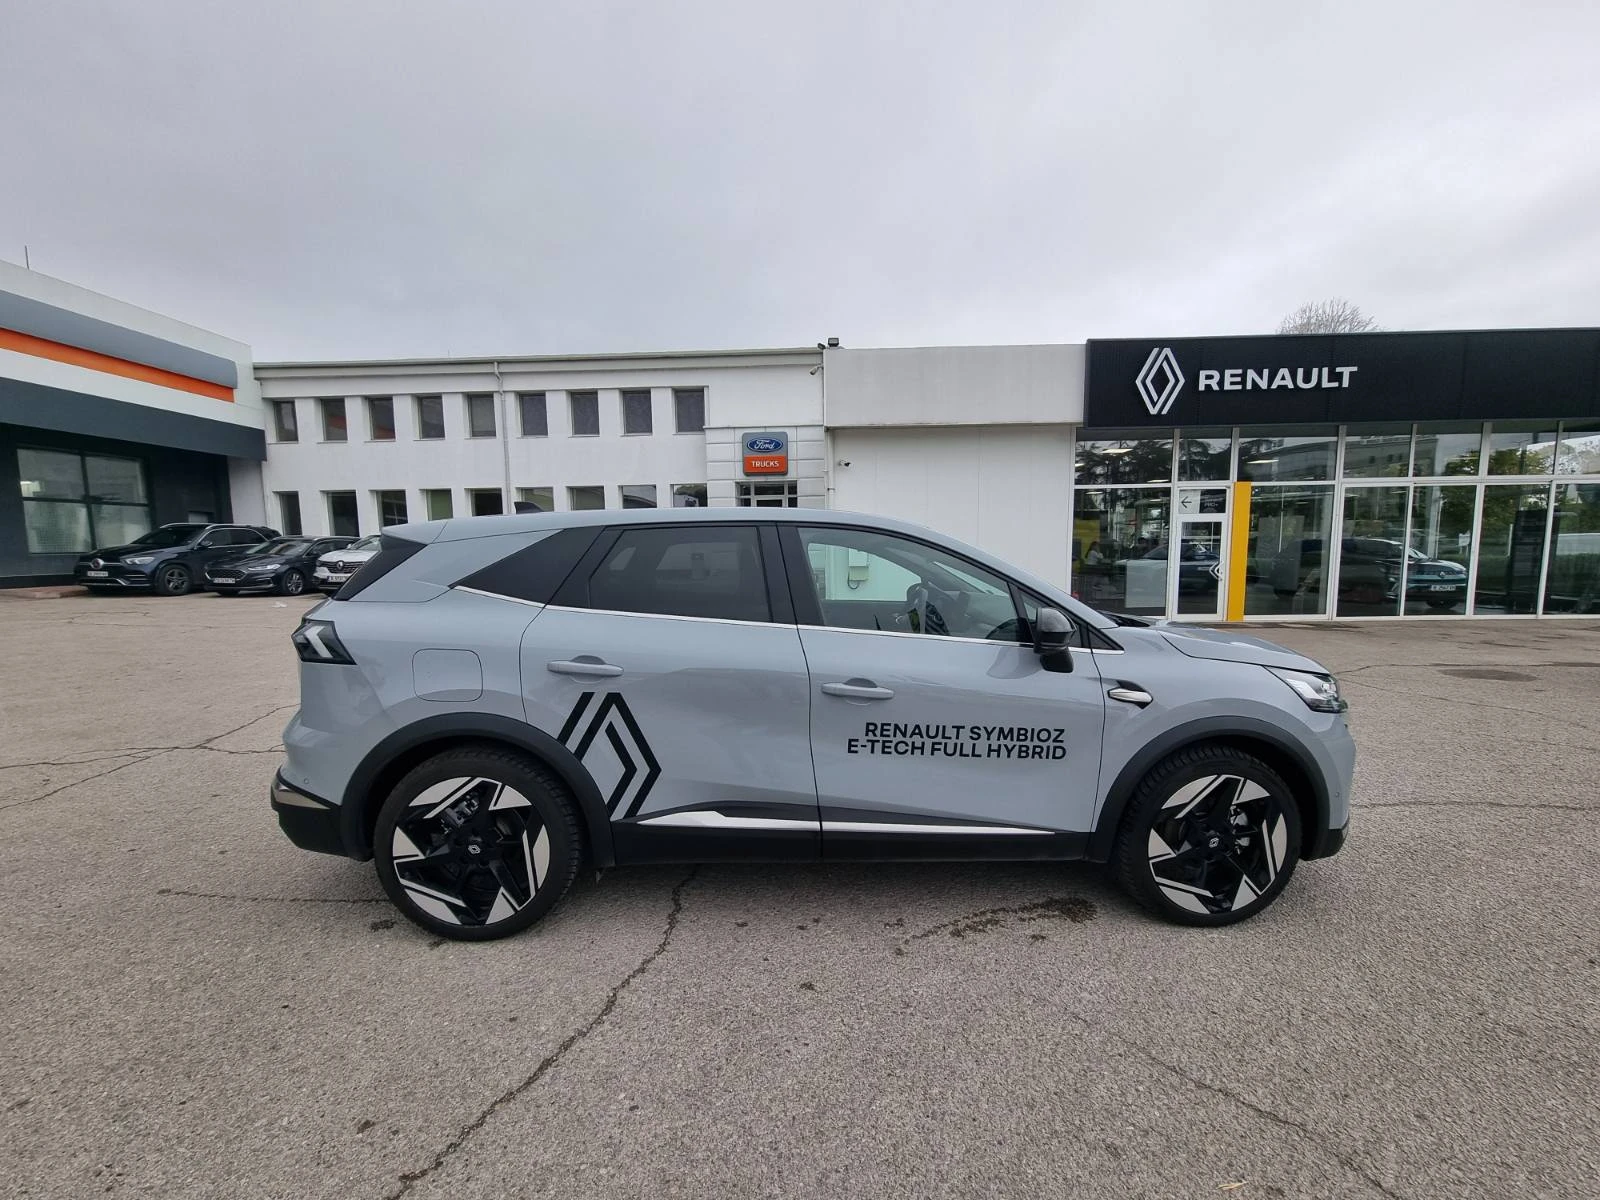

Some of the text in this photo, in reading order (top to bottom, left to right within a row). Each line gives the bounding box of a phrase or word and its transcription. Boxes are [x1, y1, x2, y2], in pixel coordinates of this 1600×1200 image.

[1198, 366, 1358, 391] RENAULT
[754, 440, 775, 449] Ford
[752, 460, 780, 468] TRUCKS
[864, 722, 1065, 743] RENAULT SYMBIOZ
[847, 738, 1067, 760] E-TECH FULL HYBRID
